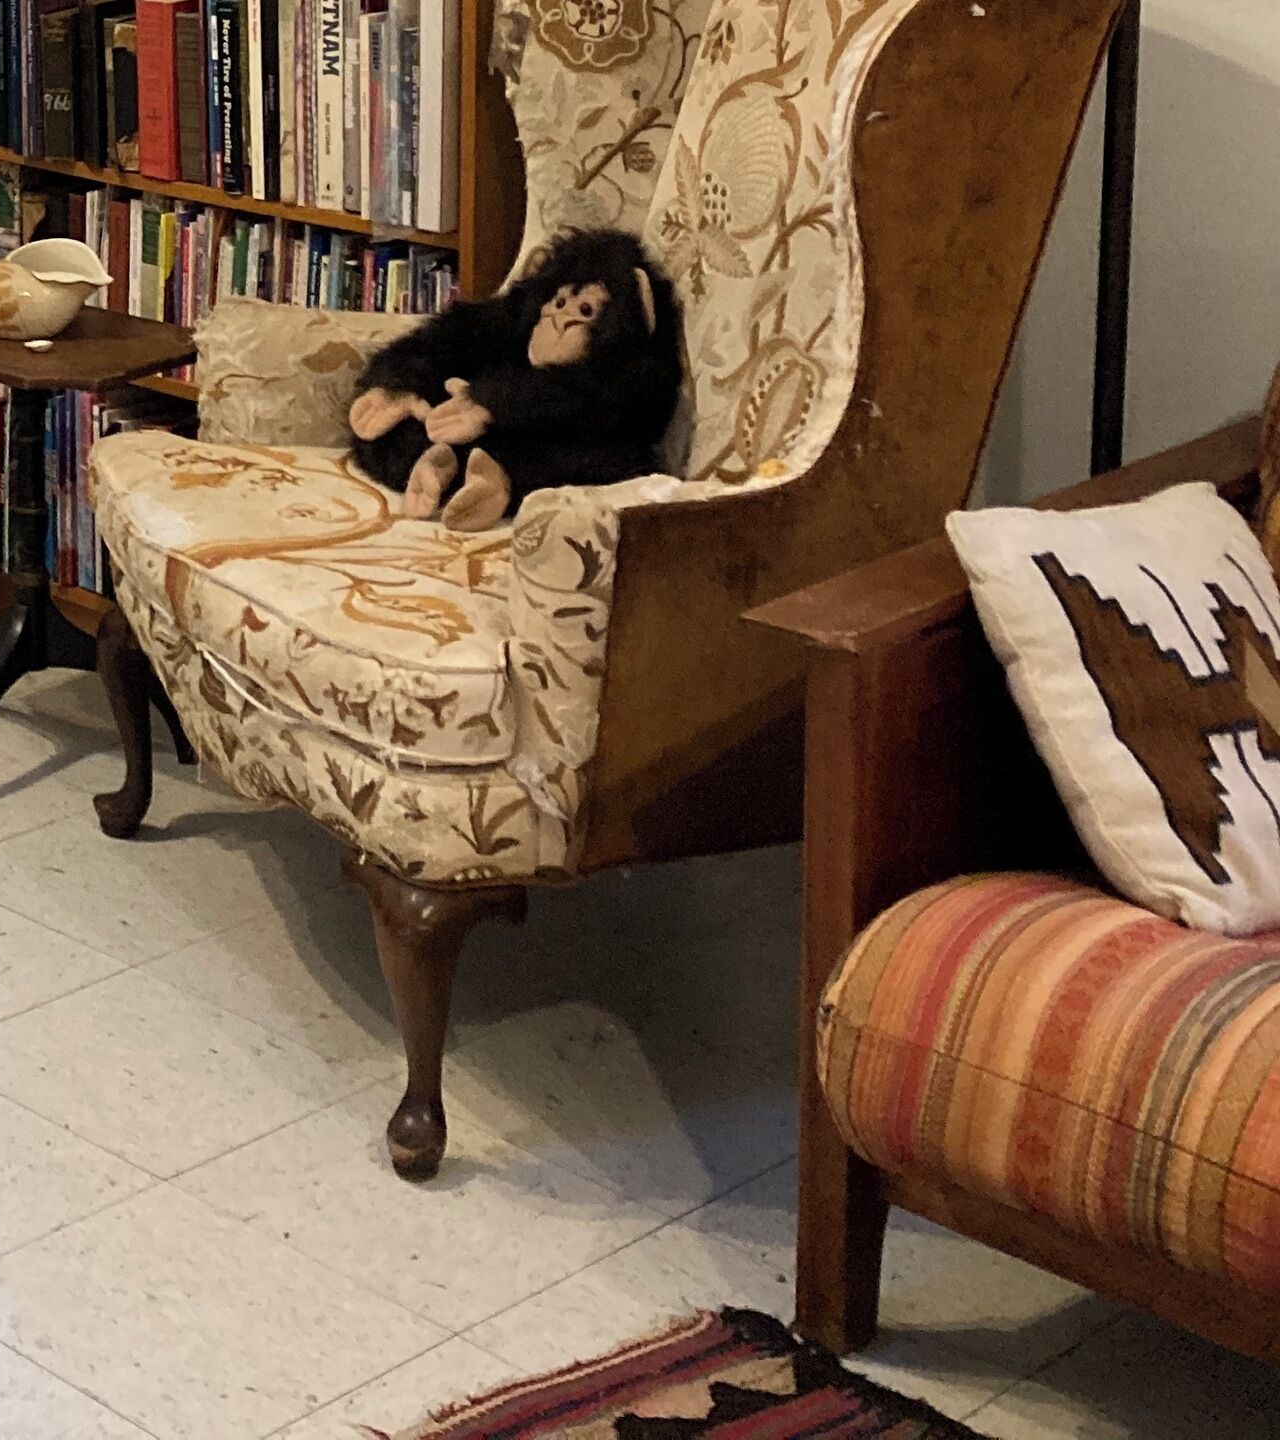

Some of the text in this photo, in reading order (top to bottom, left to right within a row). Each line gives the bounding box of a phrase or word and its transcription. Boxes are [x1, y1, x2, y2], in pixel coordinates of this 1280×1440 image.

[220, 18, 234, 164] Never Tire of Protesting
